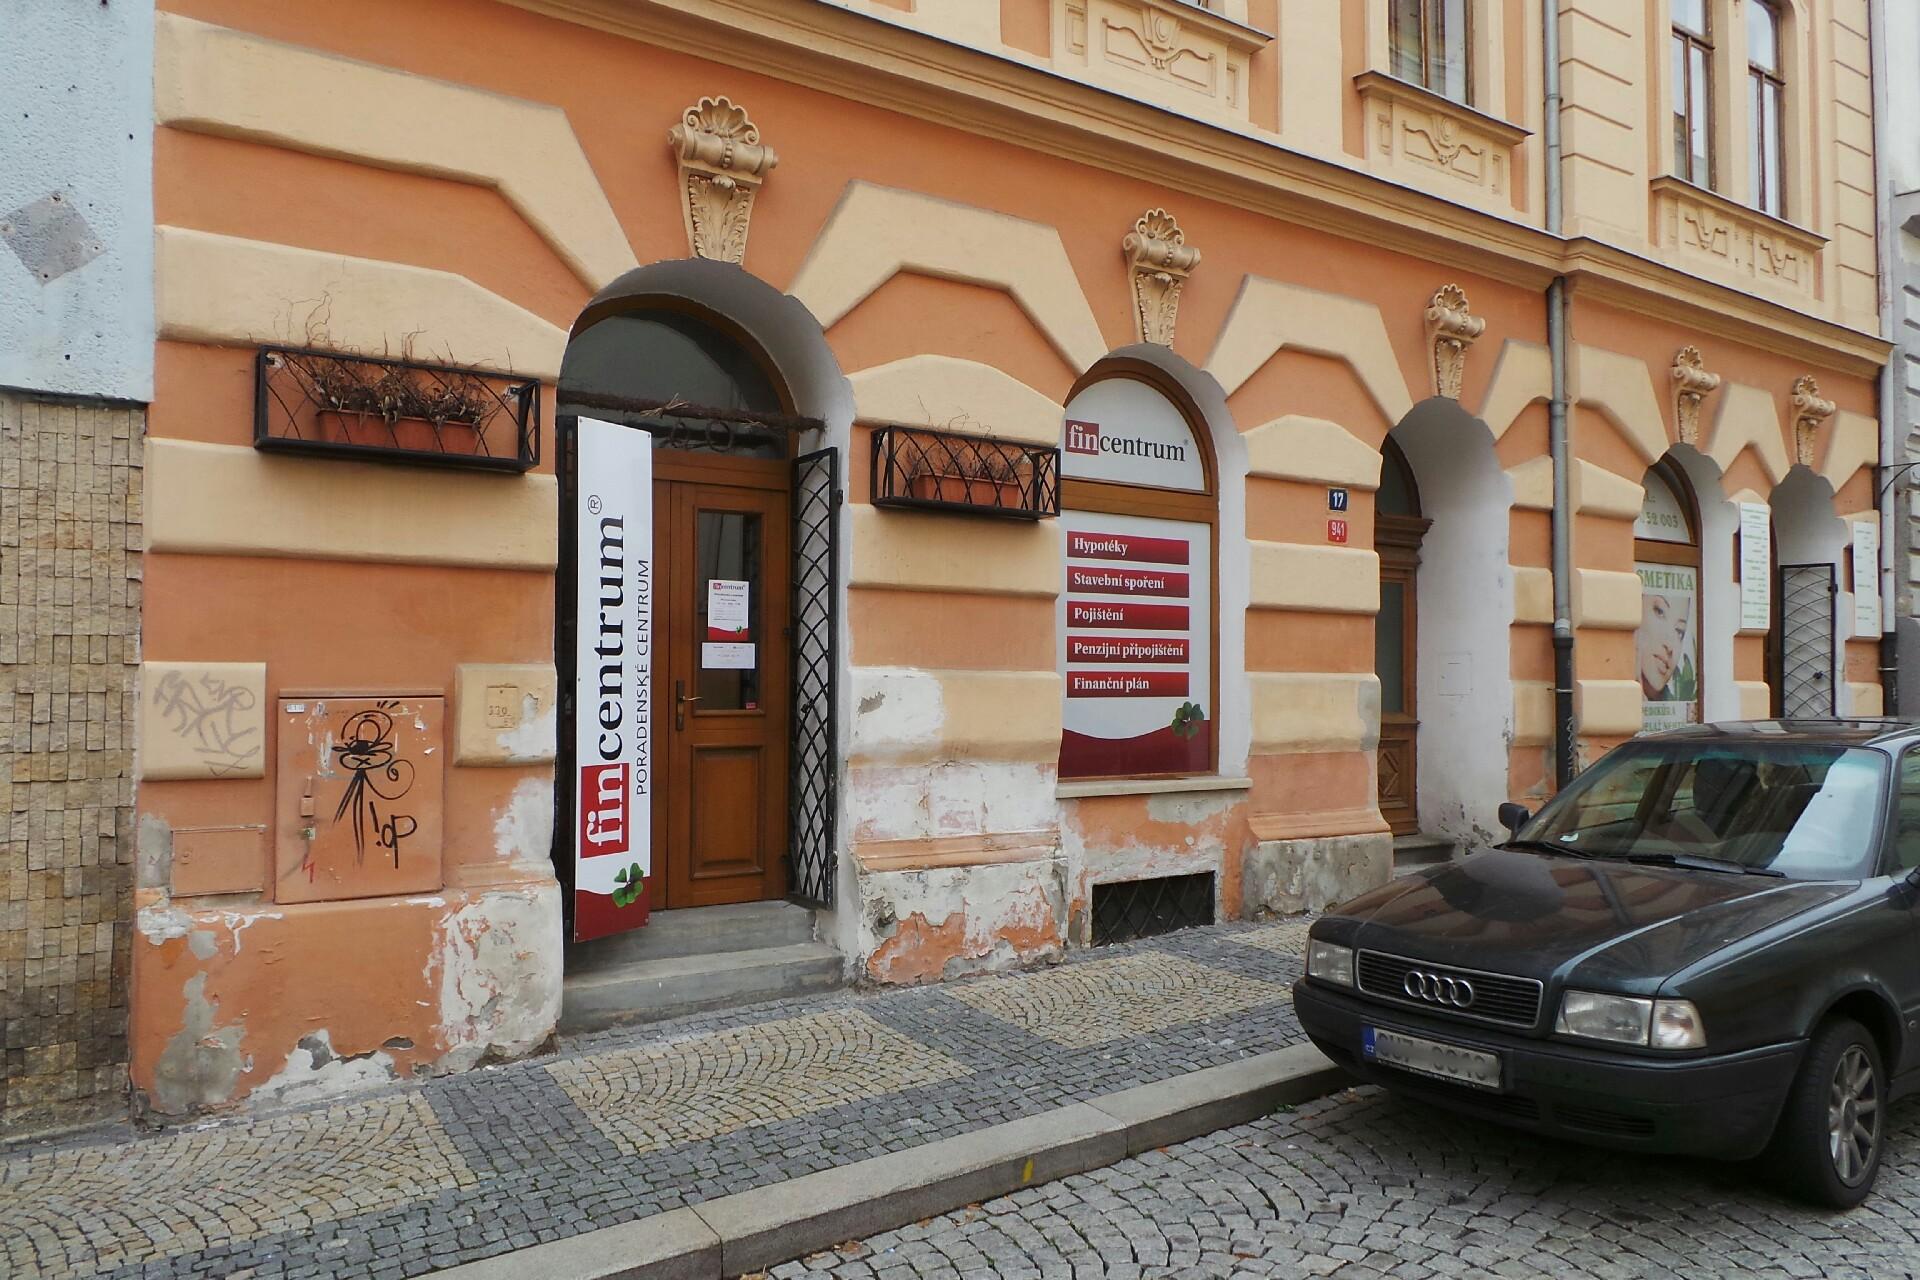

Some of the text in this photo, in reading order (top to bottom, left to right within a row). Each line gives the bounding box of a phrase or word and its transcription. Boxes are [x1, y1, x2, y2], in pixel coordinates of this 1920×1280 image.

[1068, 424, 1186, 462] fincentrum
[1332, 492, 1344, 508] 17
[1331, 521, 1345, 537] 941
[1074, 537, 1128, 556] Hypotéky
[1074, 572, 1165, 591] Stavební spoření
[1074, 607, 1124, 624] Pojištění
[1074, 640, 1184, 659] Penzijní připojištění
[635, 559, 649, 795] PORADENSKÉ CENTRUM
[1074, 677, 1150, 693] Finanční plán
